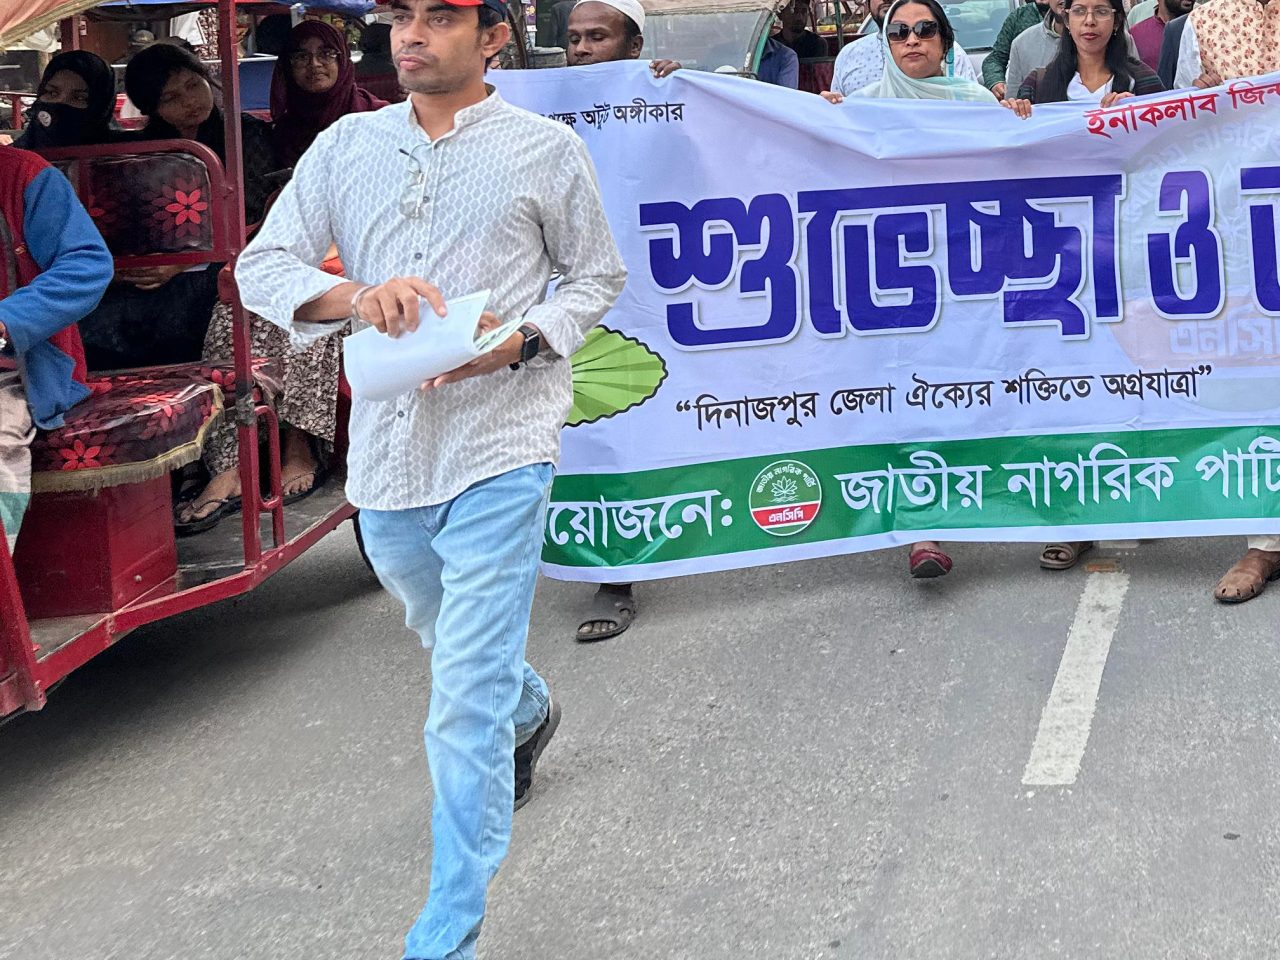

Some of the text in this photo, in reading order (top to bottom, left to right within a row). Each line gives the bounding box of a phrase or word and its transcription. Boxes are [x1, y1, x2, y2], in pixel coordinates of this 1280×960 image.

[613, 97, 686, 123] অঙ্গীকার
[1083, 92, 1218, 139] ইনাকলাব
[638, 174, 1128, 352] শুভেচ্ছা
[1147, 169, 1226, 320] ও
[675, 364, 1213, 432] “দিনাজপুর জেলা ঐক্যের শক্তিতে অগ্রযাত্রা”
[755, 463, 817, 493] জাতীয় নাগরিক পার্টি
[832, 448, 993, 514] জাতীয়
[1000, 442, 1180, 509] নাগরিক
[542, 490, 733, 548] য়োজনে:
[768, 507, 805, 523] এনসিপি
